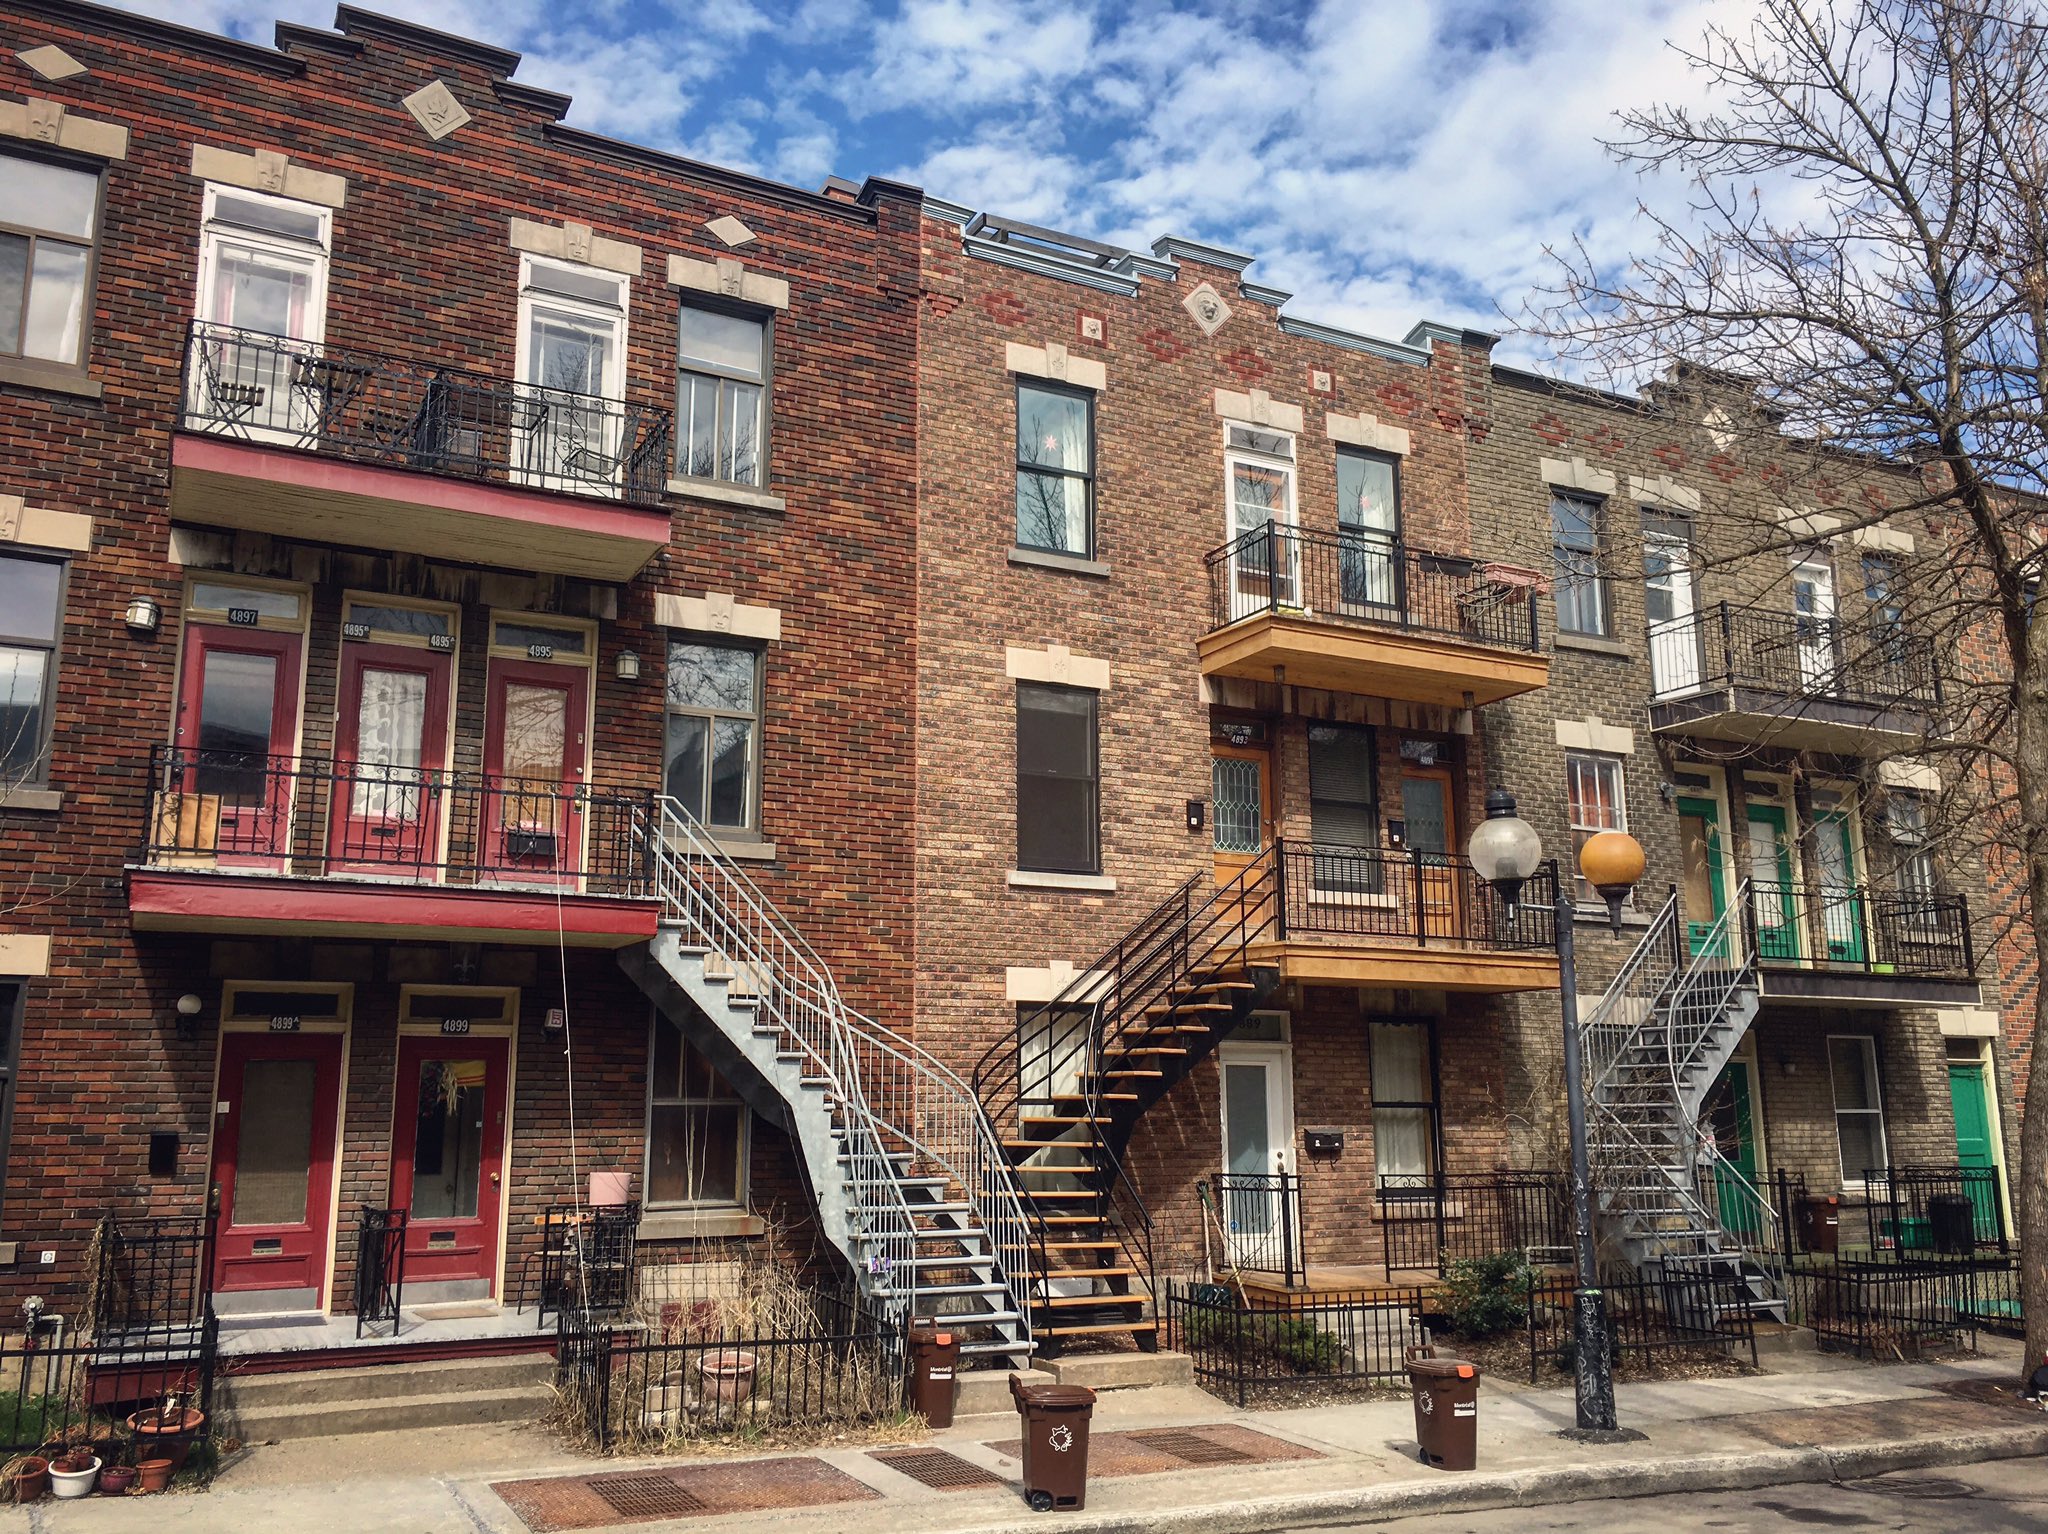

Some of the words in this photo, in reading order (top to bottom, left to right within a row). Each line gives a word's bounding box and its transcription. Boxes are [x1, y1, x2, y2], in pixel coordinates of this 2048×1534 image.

[230, 609, 257, 624] 4897
[528, 644, 552, 659] 4895
[1231, 734, 1249, 745] 4893
[551, 1009, 562, 1025] EXIT
[443, 1019, 469, 1032] 4899
